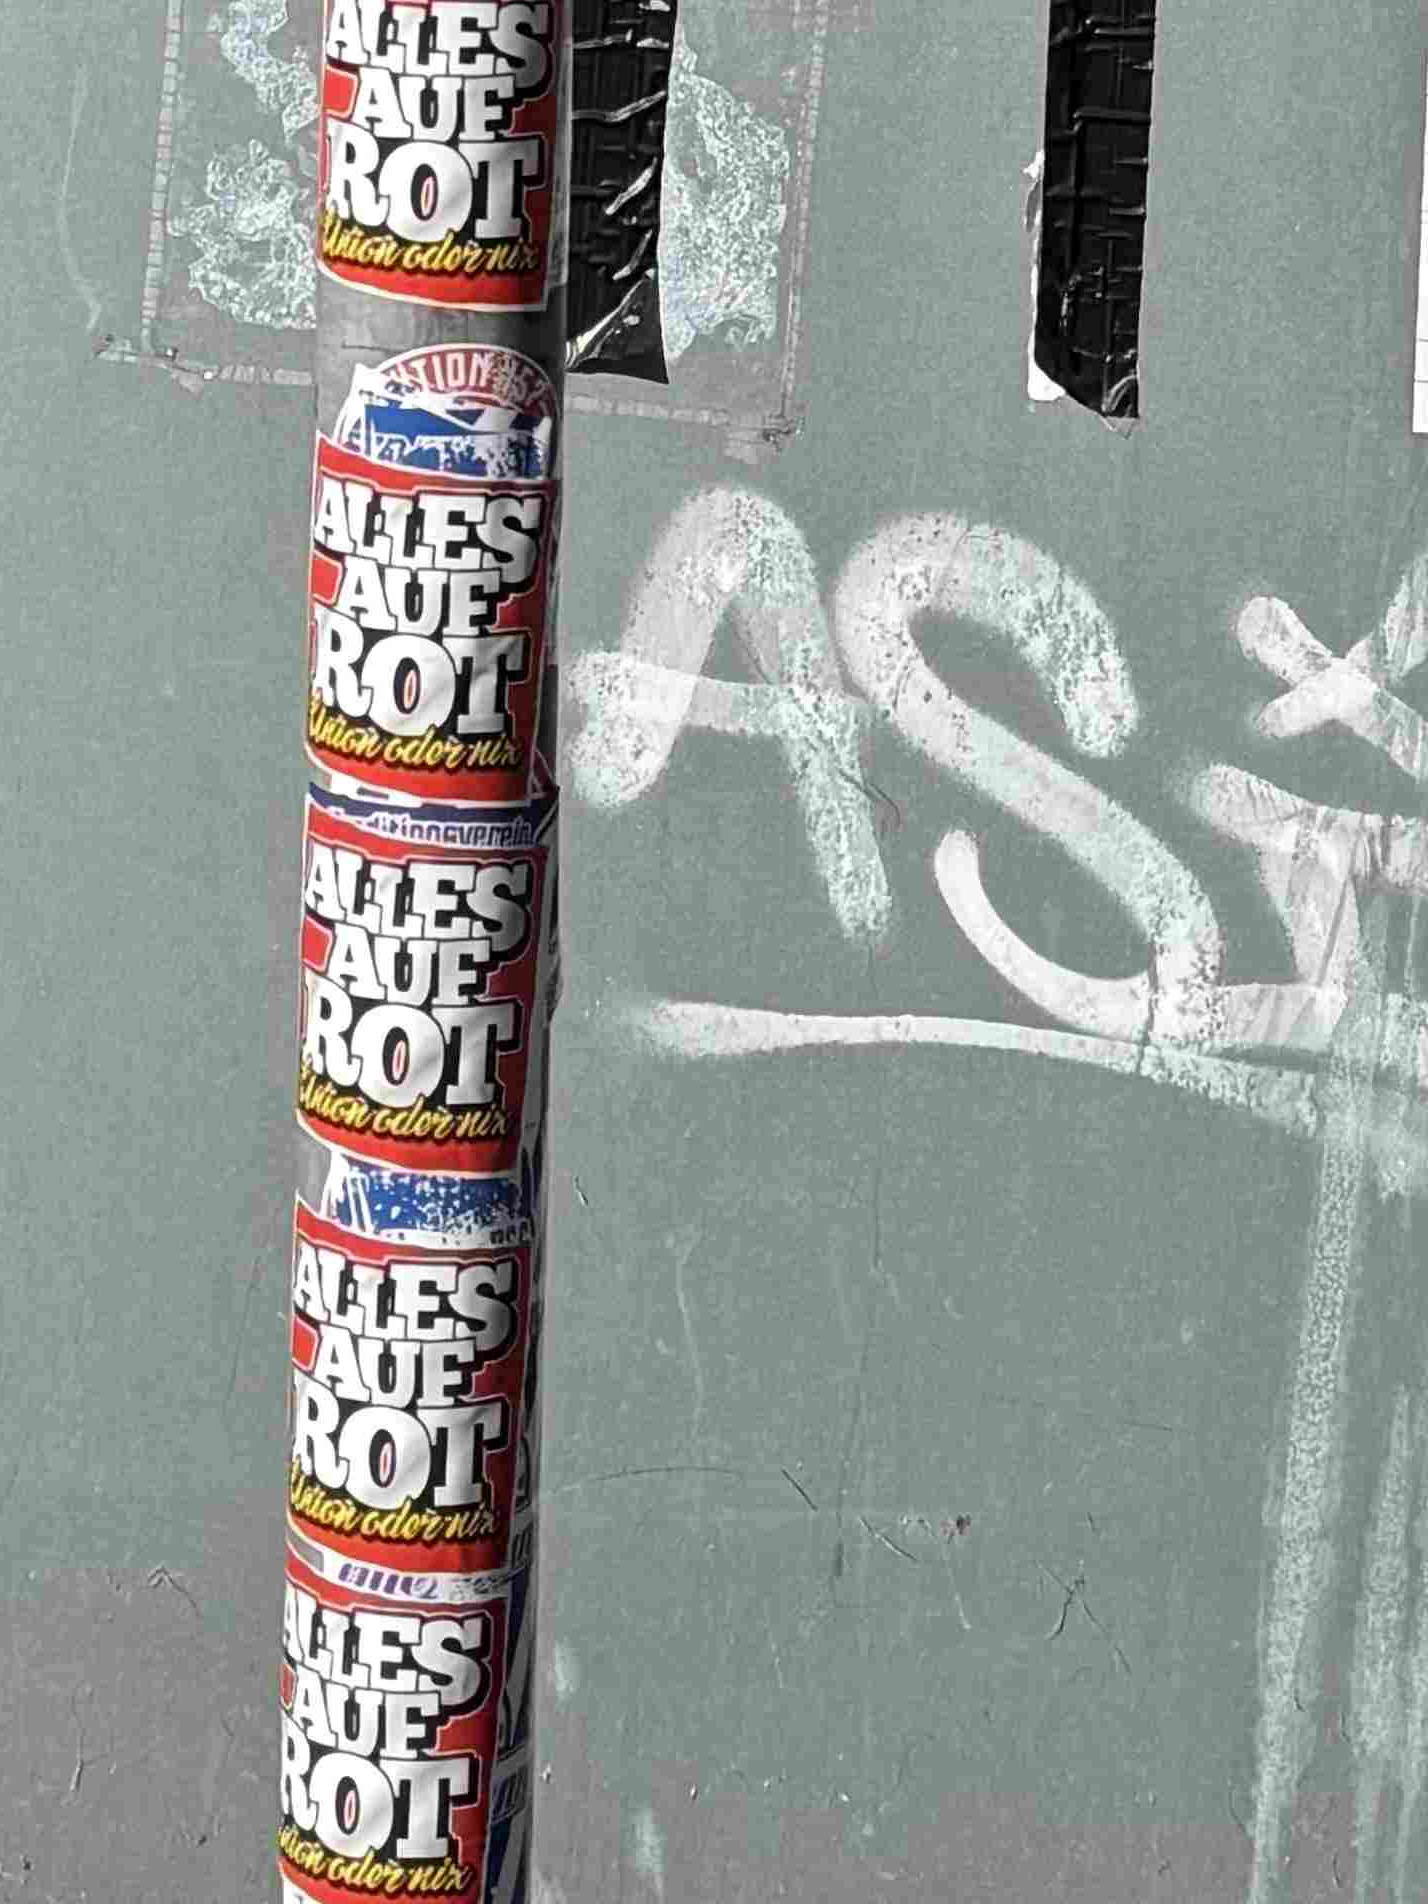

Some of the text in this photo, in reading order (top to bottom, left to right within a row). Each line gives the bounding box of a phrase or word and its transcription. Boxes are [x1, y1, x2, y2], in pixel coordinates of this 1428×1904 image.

[351, 67, 514, 142] AUF
[323, 118, 539, 242] ROT
[314, 479, 541, 583] ALLES
[336, 554, 500, 636] AUF
[313, 603, 524, 736] ROT
[305, 845, 529, 952] ALLES
[326, 923, 490, 1005] AUF
[303, 973, 514, 1107] ROT
[294, 1244, 514, 1351] ALLES
[315, 1323, 476, 1407] AUF
[293, 1369, 502, 1508] ROT
[284, 1583, 481, 1706] ALLES
[294, 1669, 441, 1759] AUF
[282, 1717, 469, 1859] ROT
